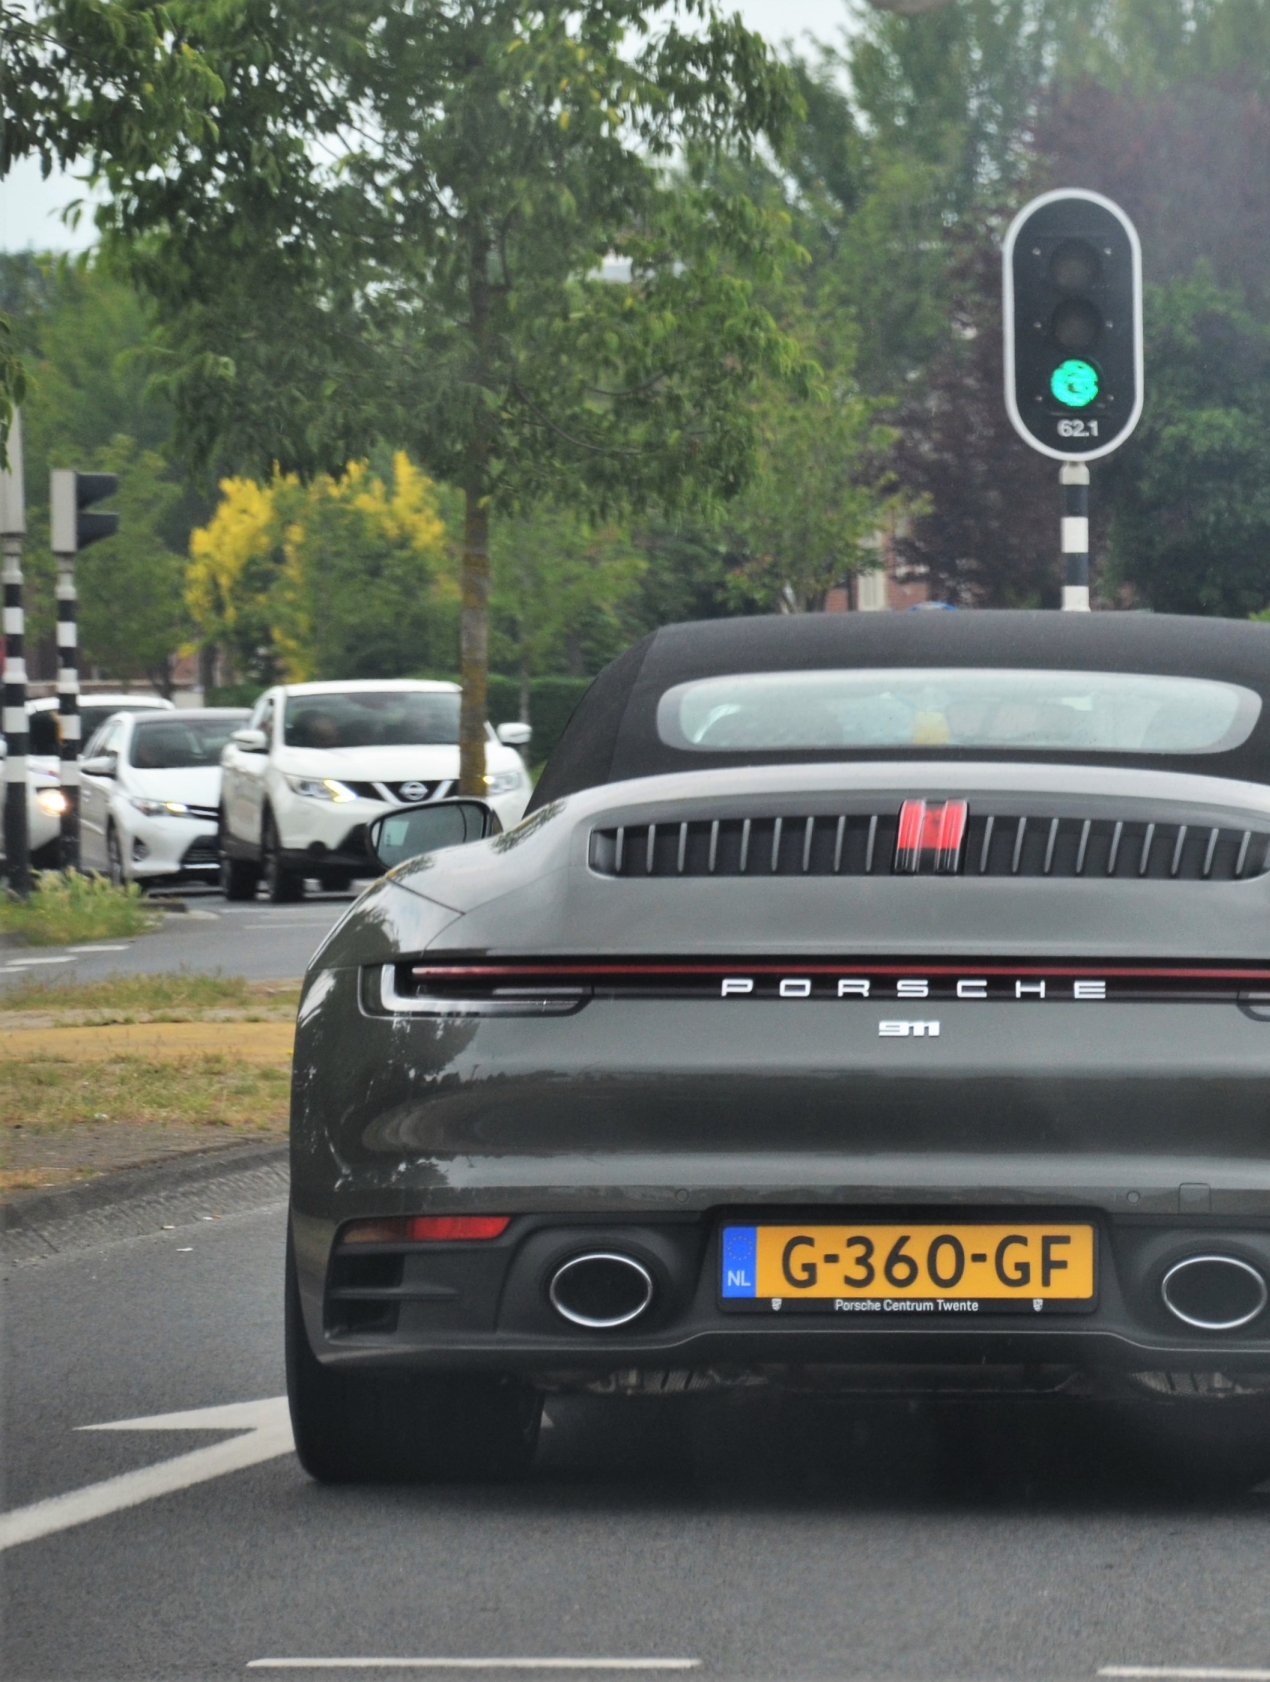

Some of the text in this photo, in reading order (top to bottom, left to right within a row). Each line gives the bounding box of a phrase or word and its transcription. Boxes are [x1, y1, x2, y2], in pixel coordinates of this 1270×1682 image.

[1057, 418, 1099, 437] 62.1
[721, 979, 1106, 999] PORSCHE
[878, 1020, 940, 1036] 911
[782, 1234, 1071, 1289] G-360-GF
[727, 1270, 751, 1287] NL
[835, 1299, 979, 1311] Porsche Centrum Twente
